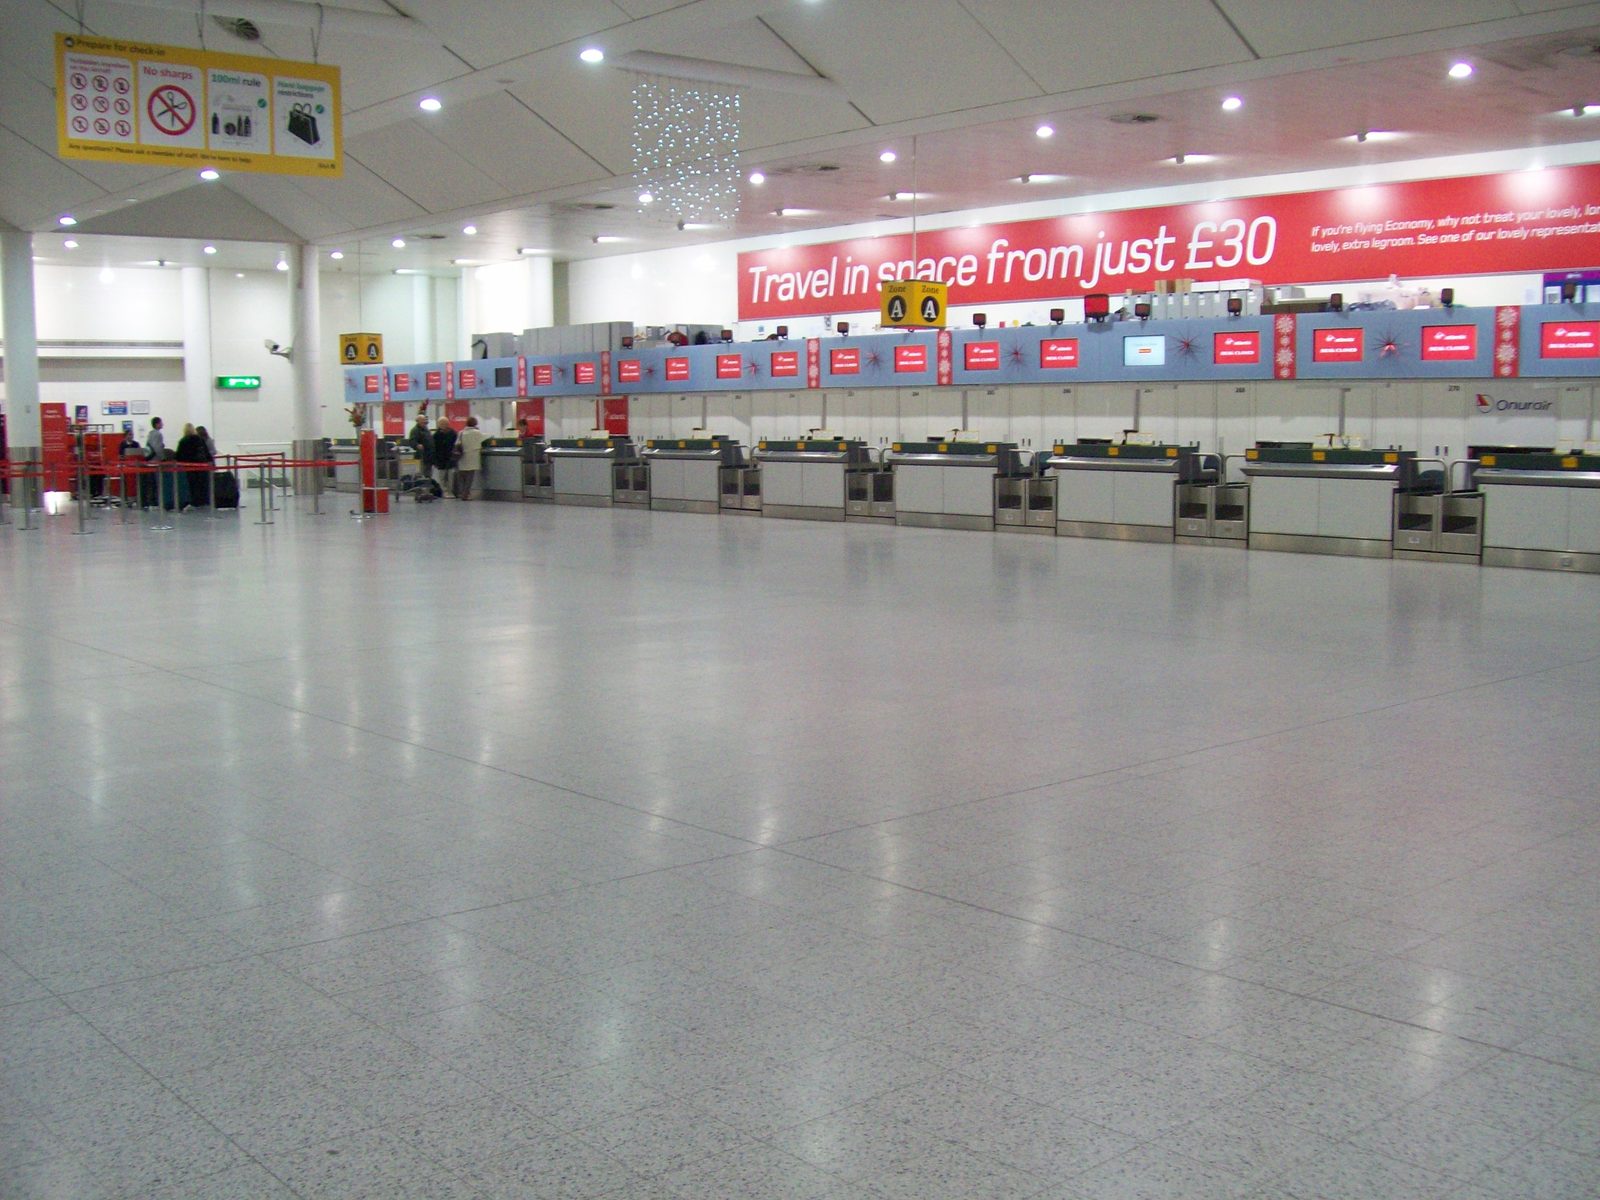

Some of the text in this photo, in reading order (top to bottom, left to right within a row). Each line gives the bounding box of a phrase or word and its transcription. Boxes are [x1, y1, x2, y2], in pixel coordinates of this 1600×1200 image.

[77, 39, 165, 56] Prepare for check-in
[143, 66, 193, 80] No sharps
[211, 73, 261, 88] 100ml rule
[1311, 226, 1321, 237] If
[1320, 224, 1353, 239] you're
[1354, 221, 1385, 237] flying
[1384, 219, 1436, 232] Economy,
[1437, 214, 1461, 229] why
[1460, 213, 1482, 226] not
[1483, 211, 1515, 225] treat
[1515, 210, 1545, 224] your
[1545, 204, 1583, 219] lovely,
[1311, 239, 1341, 253] lovely,
[1341, 238, 1371, 251] extra
[1371, 236, 1417, 250] legroom.
[1416, 233, 1439, 246] See
[1439, 233, 1460, 245] one
[1460, 229, 1476, 242] of
[1475, 231, 1497, 242] our
[1496, 226, 1530, 241] lovely
[748, 256, 839, 304] Travel
[843, 255, 871, 296] in
[986, 238, 1085, 285] from
[1079, 224, 1177, 290] just
[1184, 215, 1279, 271] £30
[887, 284, 907, 293] Zone
[921, 284, 940, 294] Zone
[890, 299, 904, 318] A
[923, 299, 937, 319] A
[347, 345, 356, 358] A
[368, 345, 378, 358] A
[1496, 399, 1553, 411] Onurair
